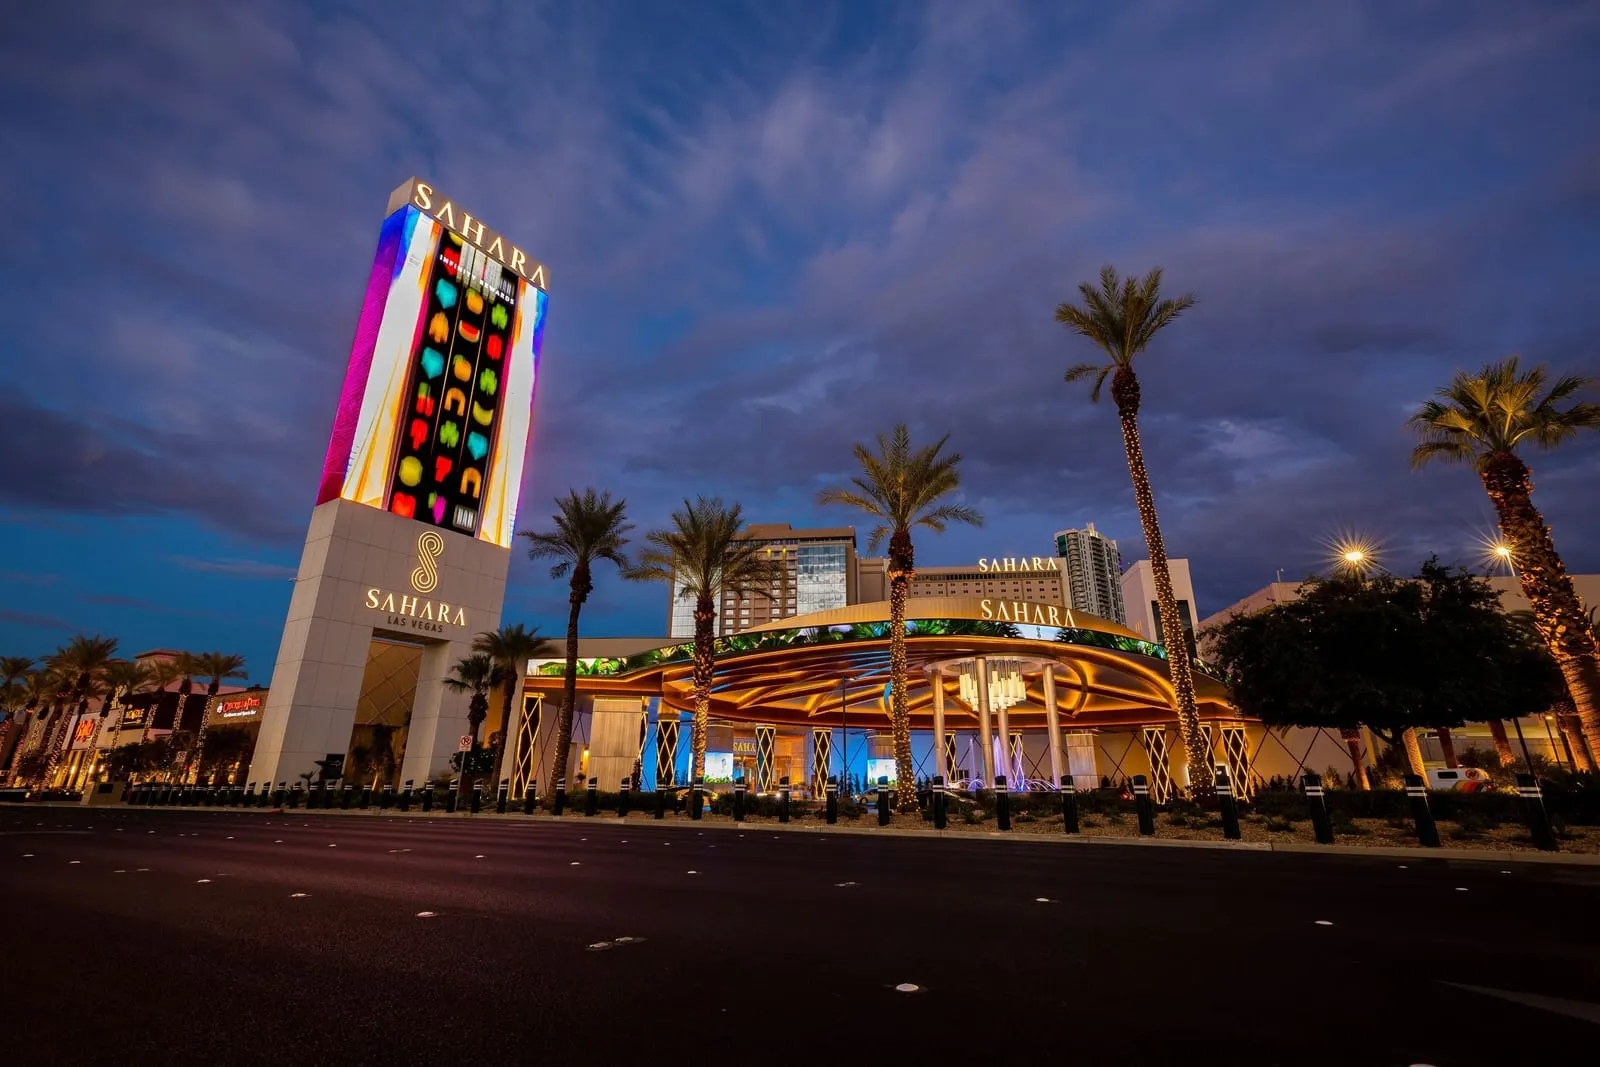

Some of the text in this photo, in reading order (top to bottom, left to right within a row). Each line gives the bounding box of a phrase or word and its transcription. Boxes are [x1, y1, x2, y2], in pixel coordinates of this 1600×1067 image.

[414, 183, 548, 291] SAHARA
[440, 254, 476, 280] INFINITY
[480, 279, 514, 305] REWARDS
[978, 556, 1058, 573] SAHARA
[365, 588, 465, 626] SAHARA
[981, 599, 1076, 628] SAHARA
[387, 616, 443, 633] LAS VEGAS
[733, 742, 756, 752] SAHA
